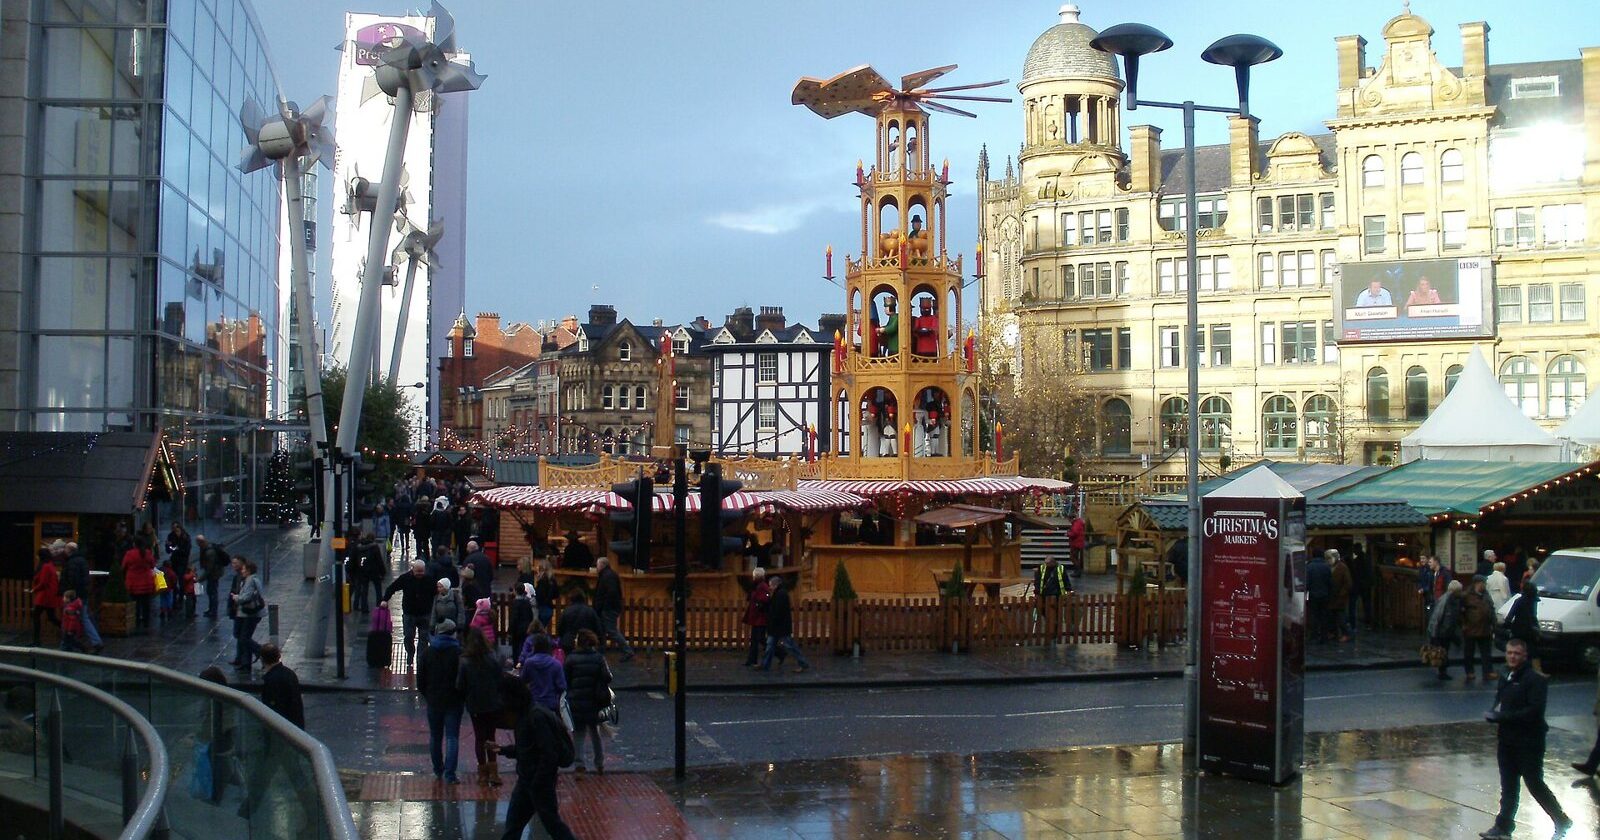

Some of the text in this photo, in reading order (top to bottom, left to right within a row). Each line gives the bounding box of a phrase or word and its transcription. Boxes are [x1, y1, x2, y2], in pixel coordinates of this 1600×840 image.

[1533, 498, 1565, 511] HOG
[1203, 517, 1278, 540] CHRISTMAS
[1224, 535, 1258, 544] MARKETS
